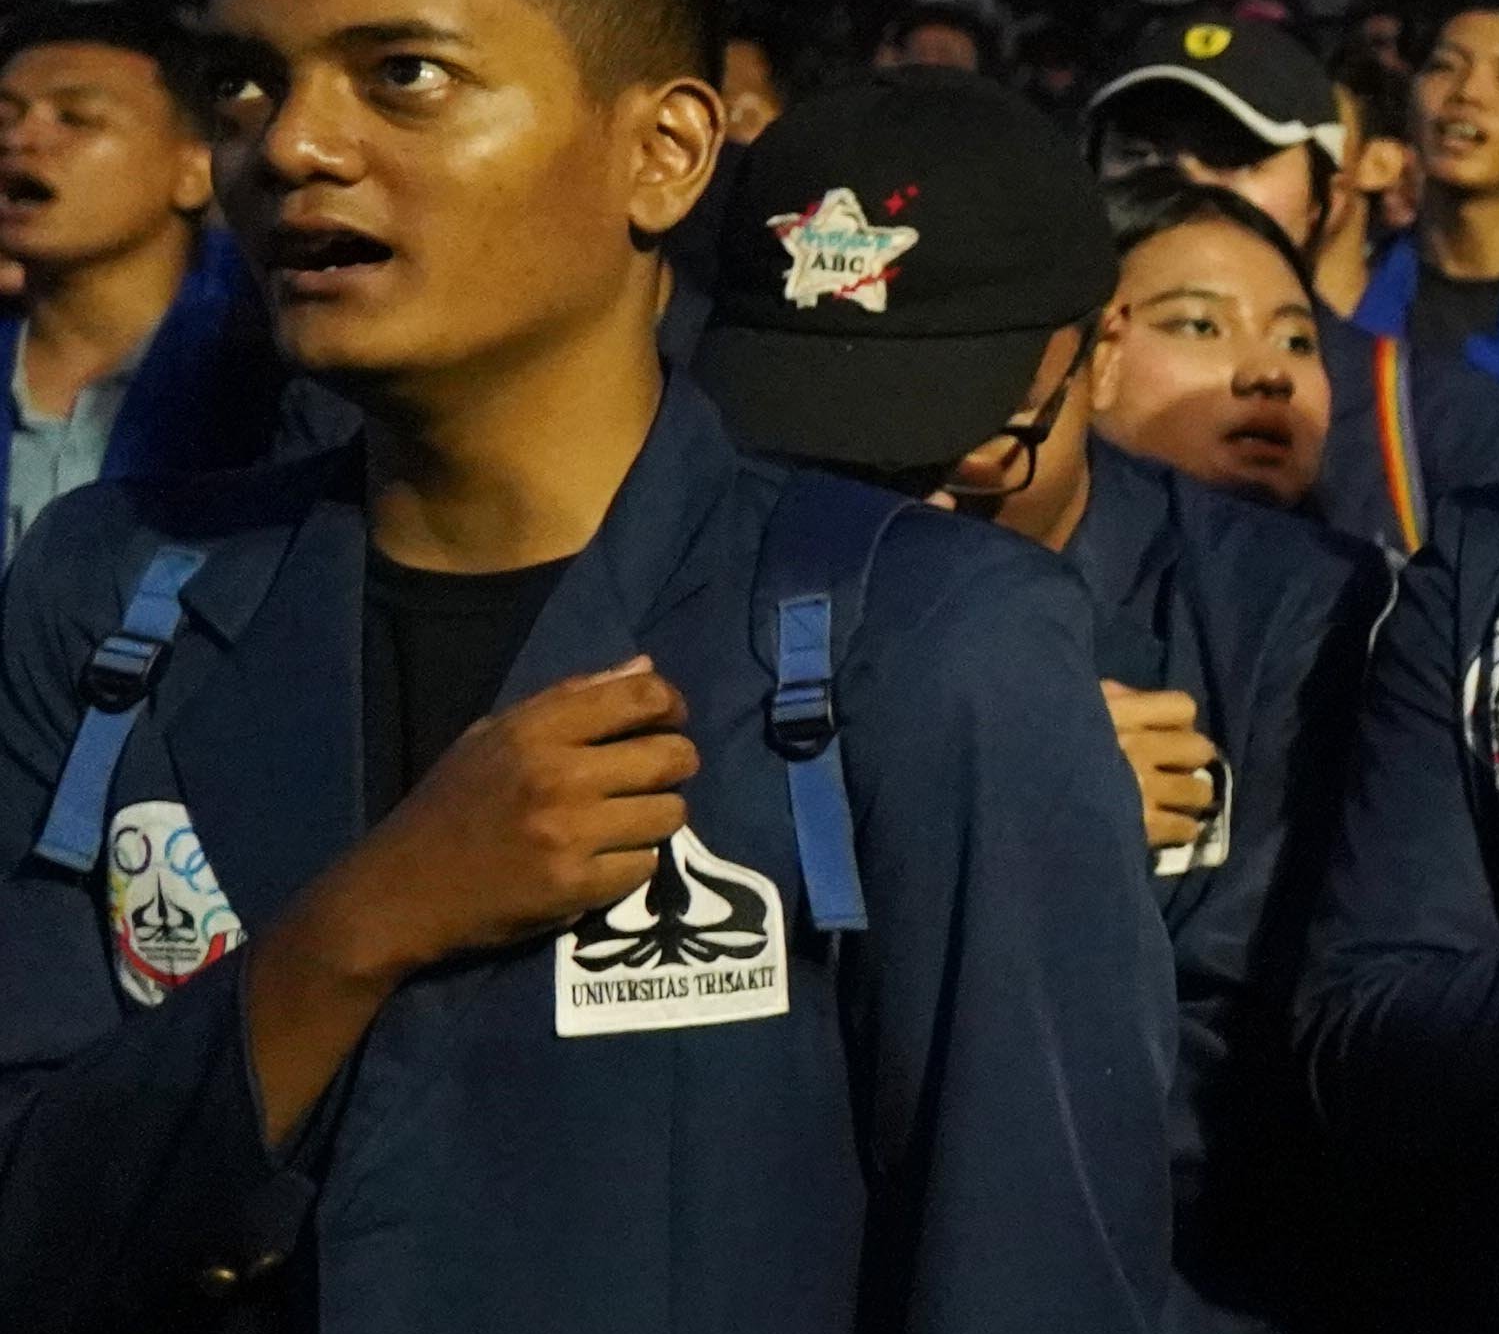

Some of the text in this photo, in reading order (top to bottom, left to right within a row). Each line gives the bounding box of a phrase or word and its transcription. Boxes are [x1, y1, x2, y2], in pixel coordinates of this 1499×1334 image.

[811, 252, 865, 274] ABC
[572, 966, 776, 1007] UNIVERSITAS TRISAKTI
